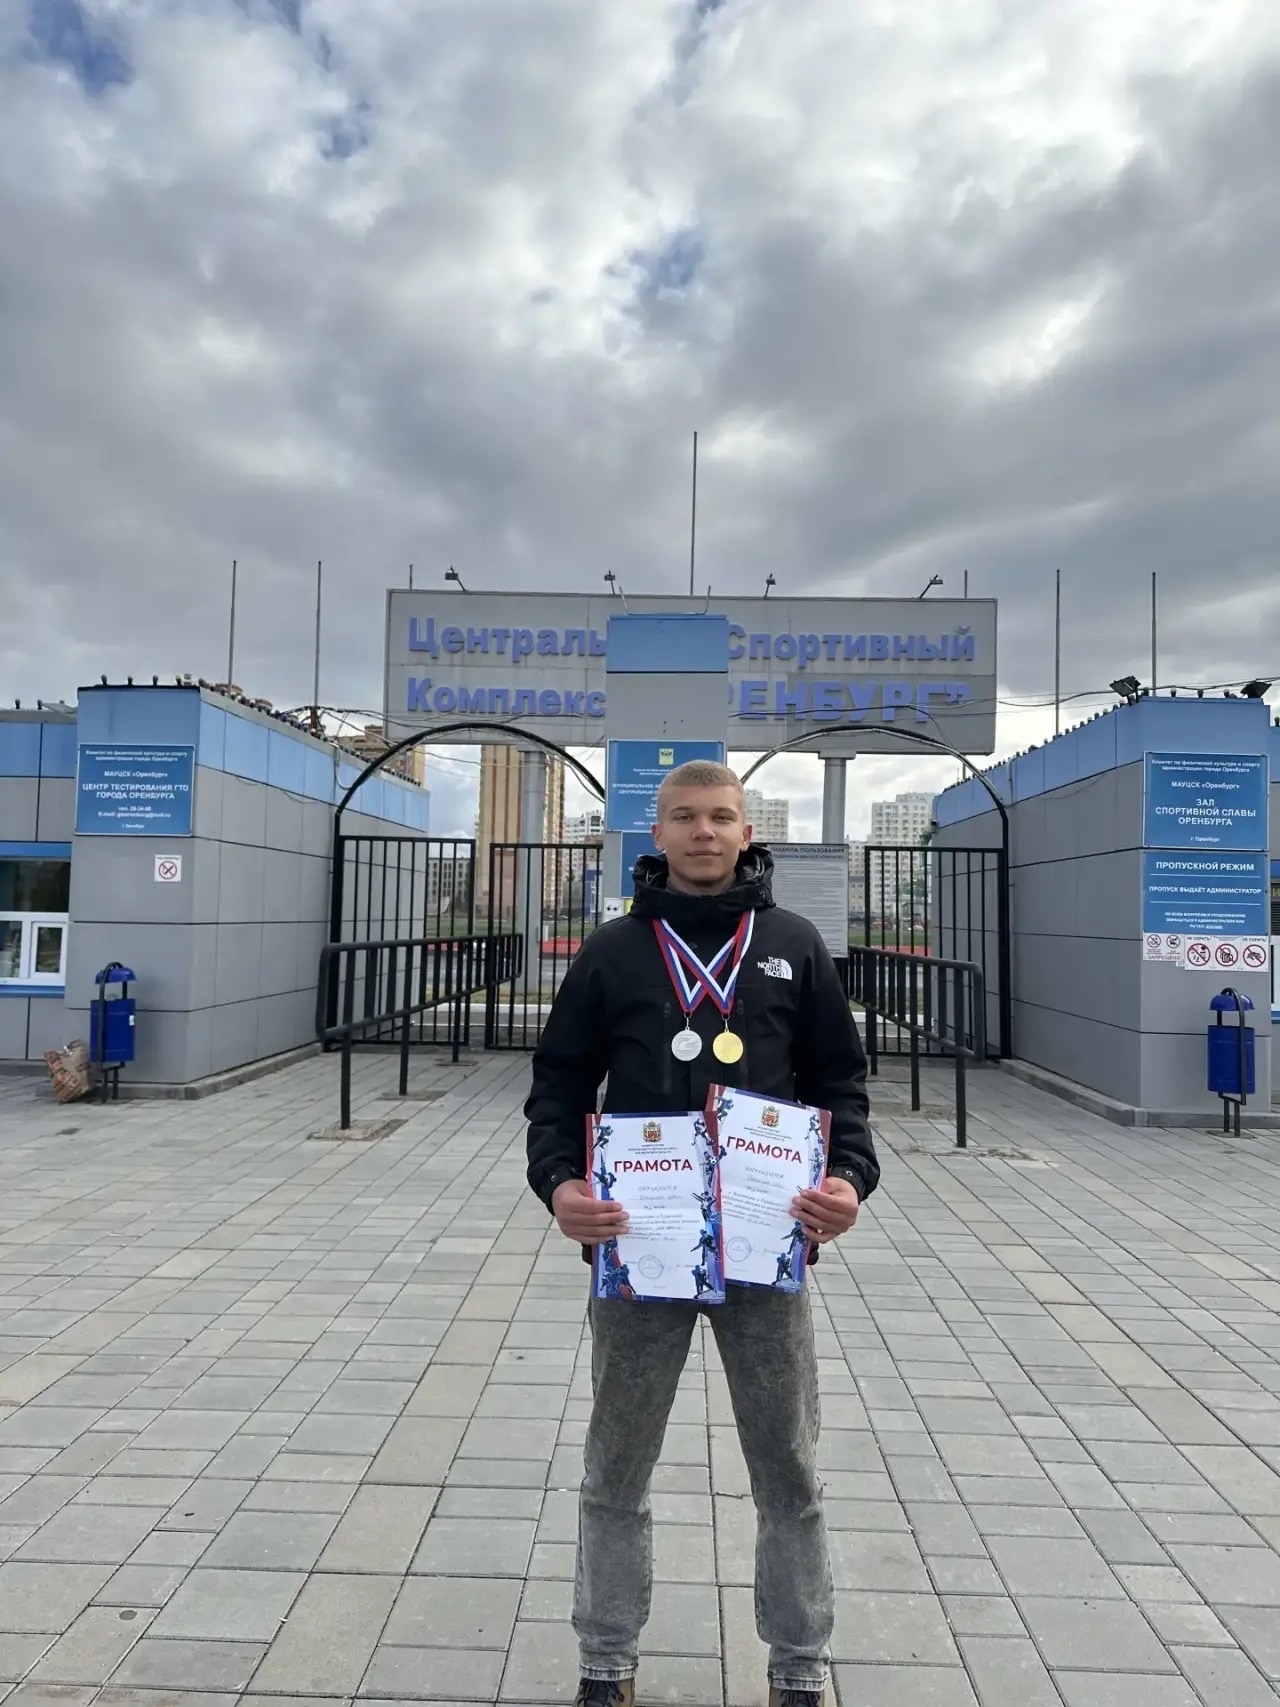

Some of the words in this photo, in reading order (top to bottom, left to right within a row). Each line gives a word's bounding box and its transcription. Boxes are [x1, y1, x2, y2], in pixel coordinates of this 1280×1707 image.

[729, 624, 975, 670] Спортивный
[407, 677, 606, 717] Комплекс
[728, 680, 970, 723] ЕНБУРГ”
[104, 770, 132, 778] МАУЦСК
[82, 783, 109, 791] ЦЕНТР
[110, 783, 173, 792] ТЕСТИРОВАНИЯ
[174, 784, 190, 792] ГТО
[1171, 781, 1201, 789] МАУЦСК
[1201, 782, 1240, 790] «Оренбург»
[96, 791, 128, 799] ГОРОДА
[128, 792, 175, 800] ОРЕНБУРГА
[1195, 798, 1215, 807] ЗАЛ
[1155, 806, 1219, 816] СПОРТИВНОЙ
[1221, 809, 1256, 817] СЛАВЫ
[1178, 816, 1233, 826] ОРЕНБУРГА
[1156, 861, 1219, 871] ПРОПУСКНОЙ
[1220, 863, 1255, 871] РЕЖИМ
[1206, 887, 1262, 895] АДМИНИСТРАТОР
[768, 956, 780, 965] THE
[757, 961, 781, 972] NORTH
[764, 969, 781, 978] FACE
[726, 1135, 802, 1164] ГРАМОТА
[614, 1158, 693, 1173] ГРАМОТА
